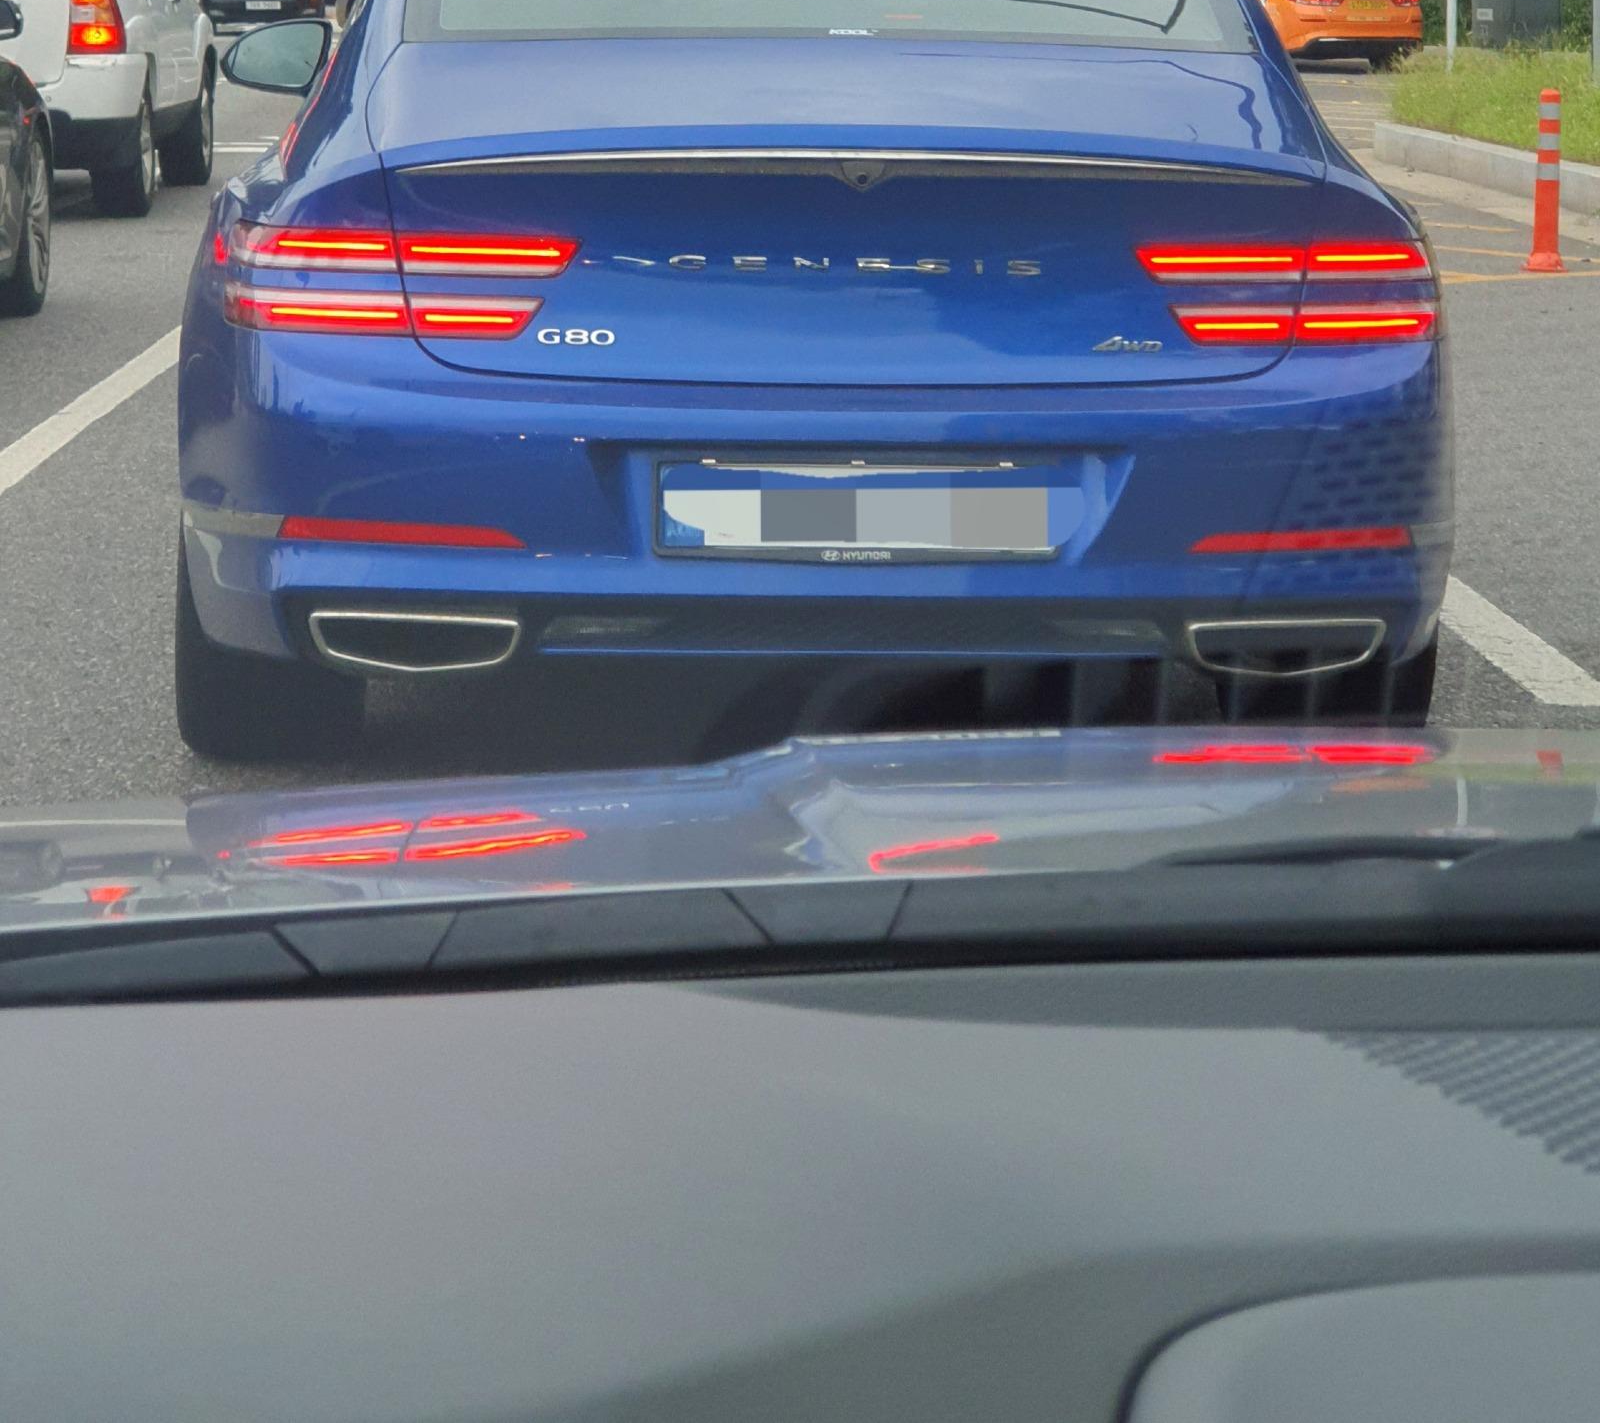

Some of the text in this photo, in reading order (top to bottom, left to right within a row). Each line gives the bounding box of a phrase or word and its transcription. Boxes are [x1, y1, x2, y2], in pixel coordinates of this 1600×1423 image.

[669, 254, 1041, 276] GENESIS
[537, 328, 615, 346] G80
[842, 550, 891, 561] HYUNDAI
